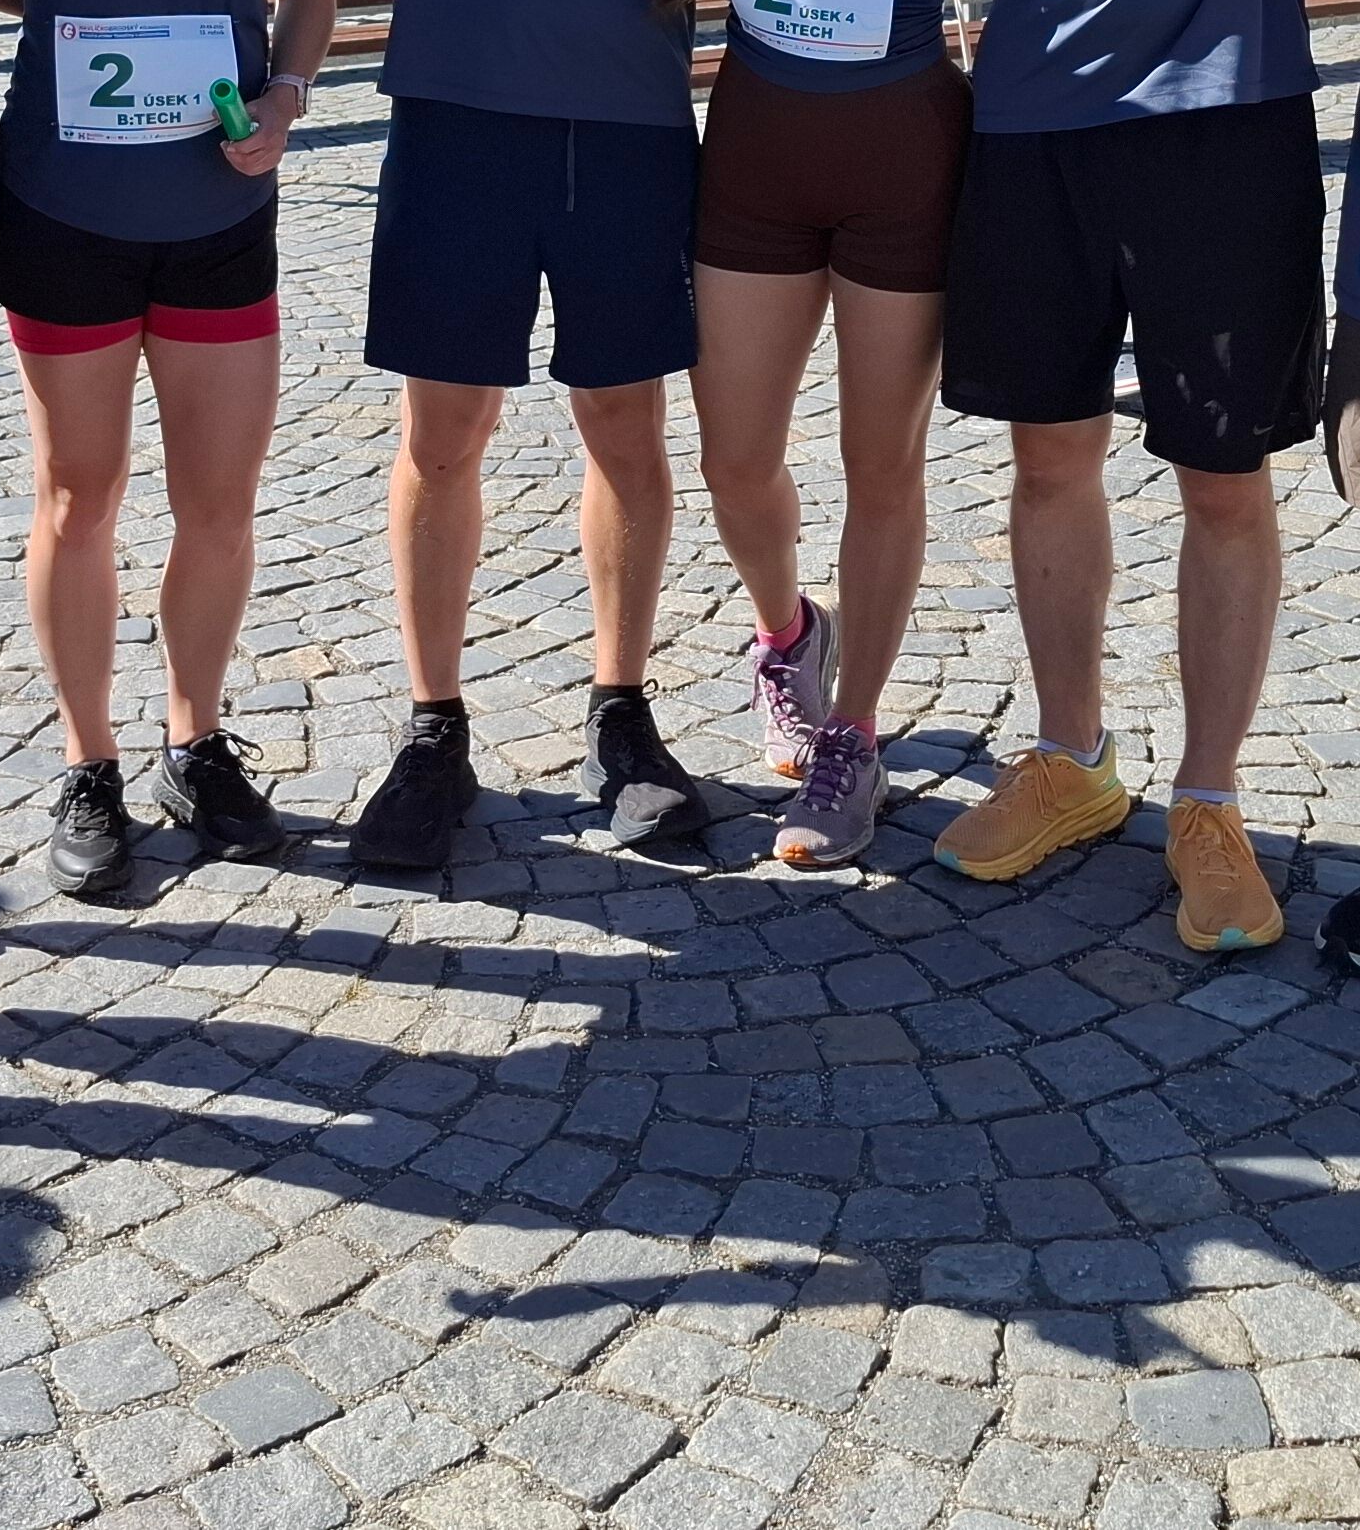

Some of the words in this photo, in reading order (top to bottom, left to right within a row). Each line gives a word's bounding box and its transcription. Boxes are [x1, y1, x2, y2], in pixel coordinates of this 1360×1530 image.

[799, 5, 842, 23] ÚSEK
[845, 12, 855, 24] 4
[775, 20, 834, 40] B:TECH
[89, 52, 135, 108] 2
[143, 94, 188, 107] ÚSEK
[192, 94, 201, 105] 1
[117, 111, 182, 126] B:TECH
